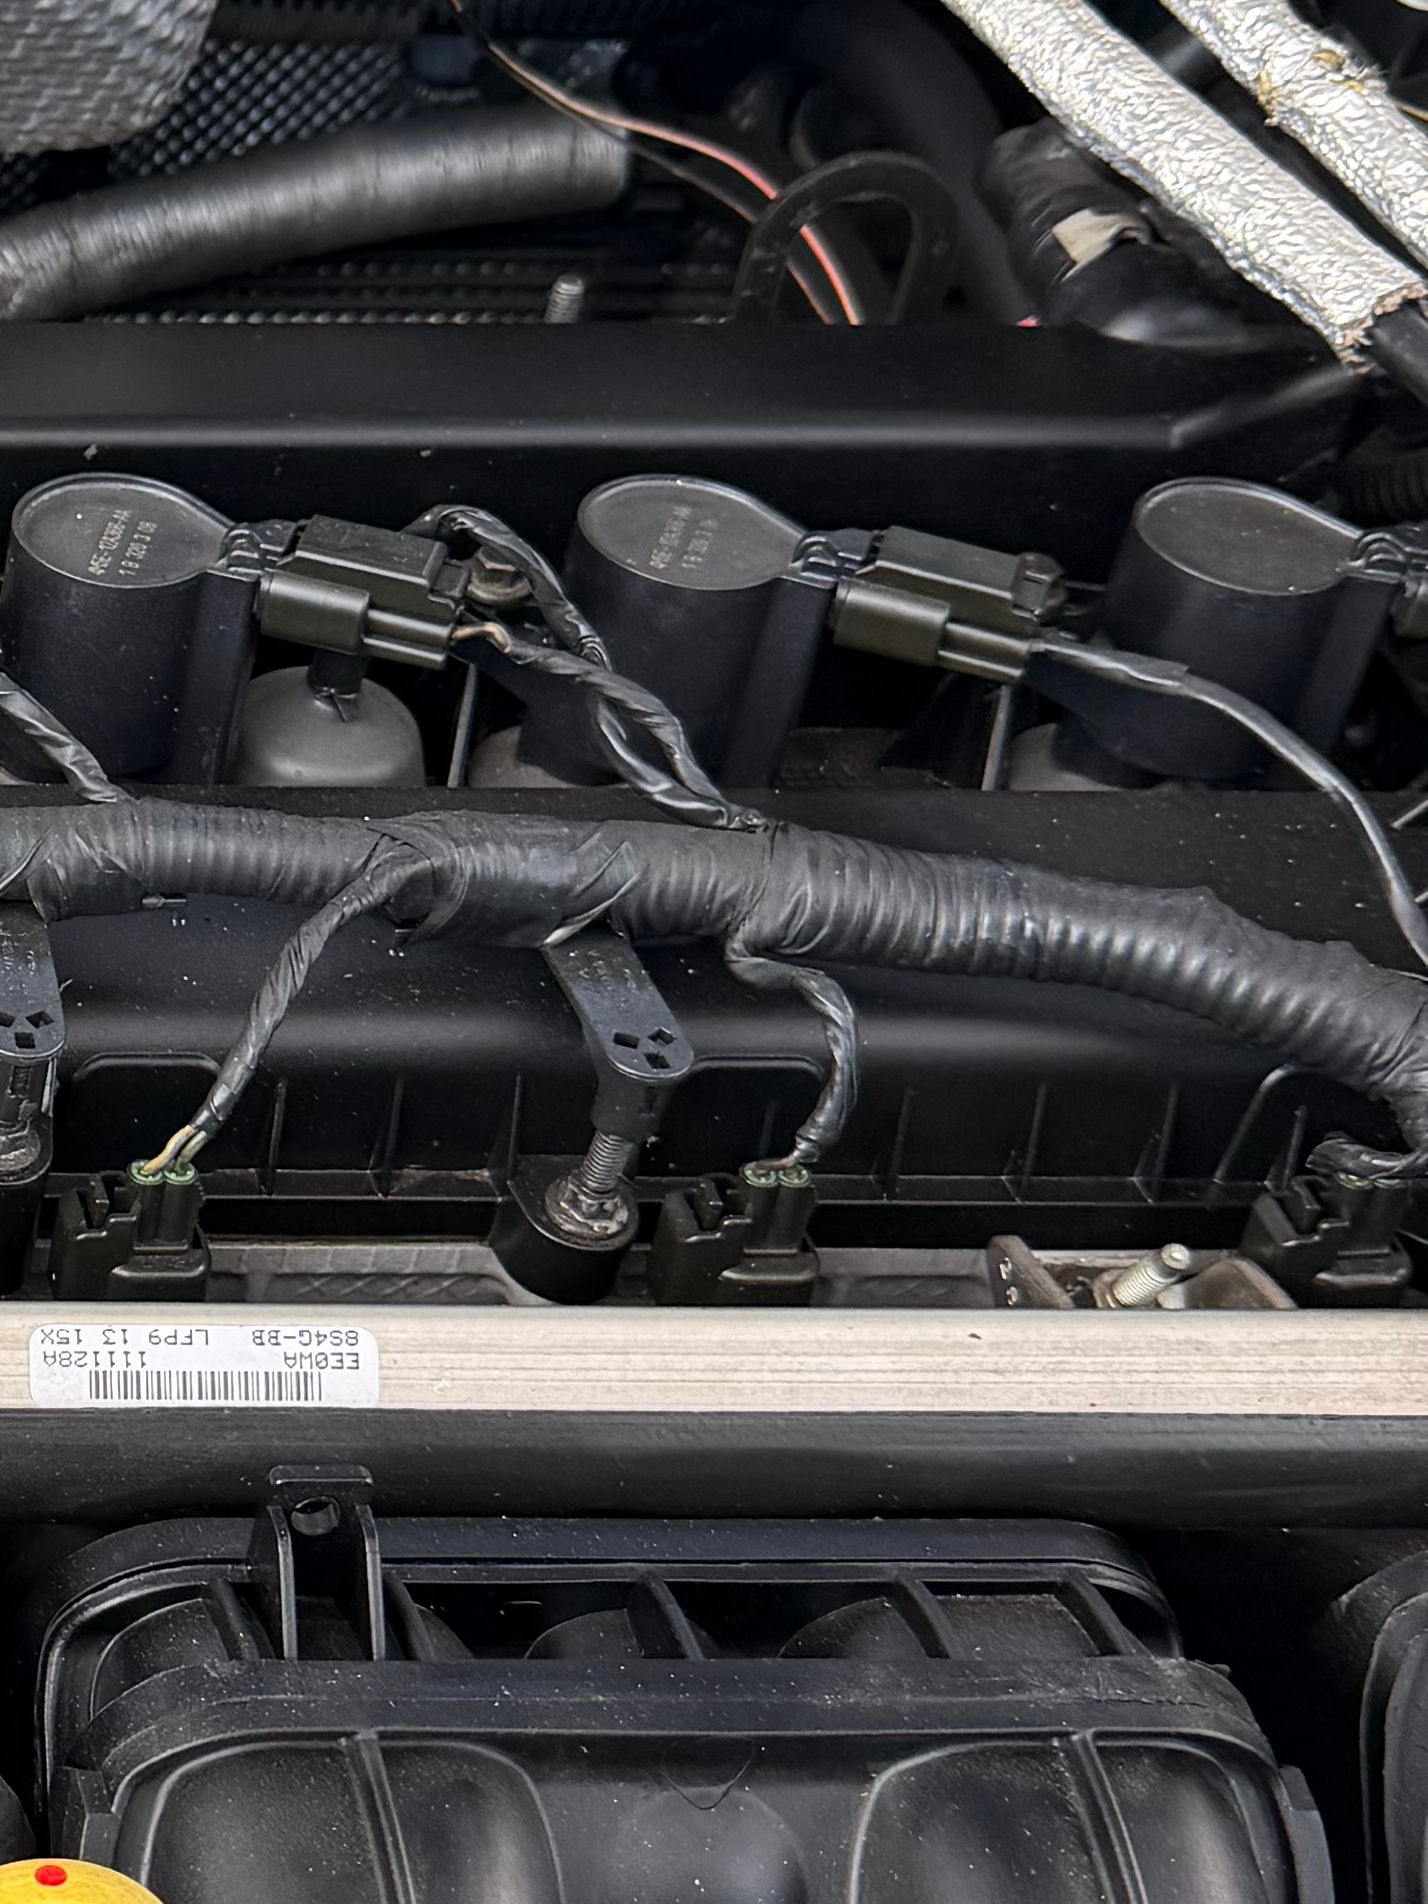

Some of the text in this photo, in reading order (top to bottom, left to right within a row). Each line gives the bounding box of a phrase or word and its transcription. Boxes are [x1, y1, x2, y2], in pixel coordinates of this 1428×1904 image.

[40, 1328, 360, 1347] 8S4G-BB LFP9 13 15X
[43, 1350, 147, 1369] 111128A
